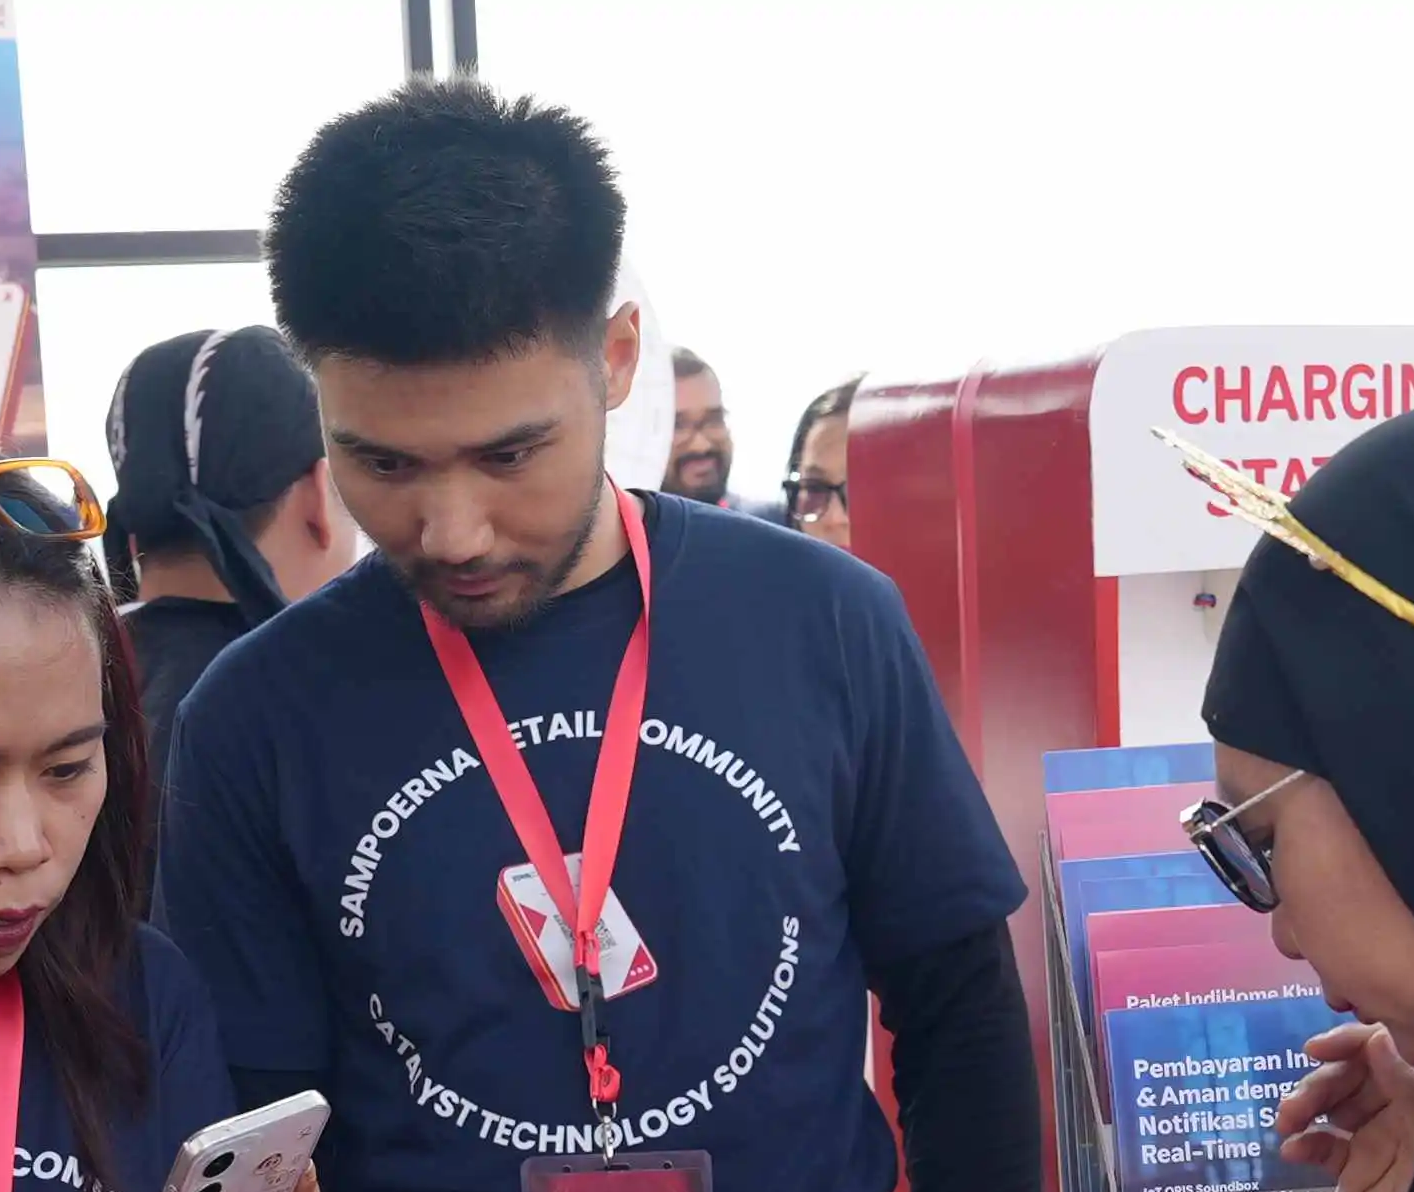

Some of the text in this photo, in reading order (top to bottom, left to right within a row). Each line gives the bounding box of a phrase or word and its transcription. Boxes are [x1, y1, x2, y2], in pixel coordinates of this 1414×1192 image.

[339, 710, 801, 939] SAMPOERNA ETAIL OMMUNITY
[369, 916, 800, 1154] CATALYST TECHNOLOGY SOLUTIONS
[1133, 1048, 1324, 1080] Pembayaran Ins
[1136, 1087, 1157, 1108] &
[1160, 1086, 1230, 1107] Aman
[1139, 1107, 1255, 1136] Notifikasi
[1141, 1140, 1261, 1165] Real-Time
